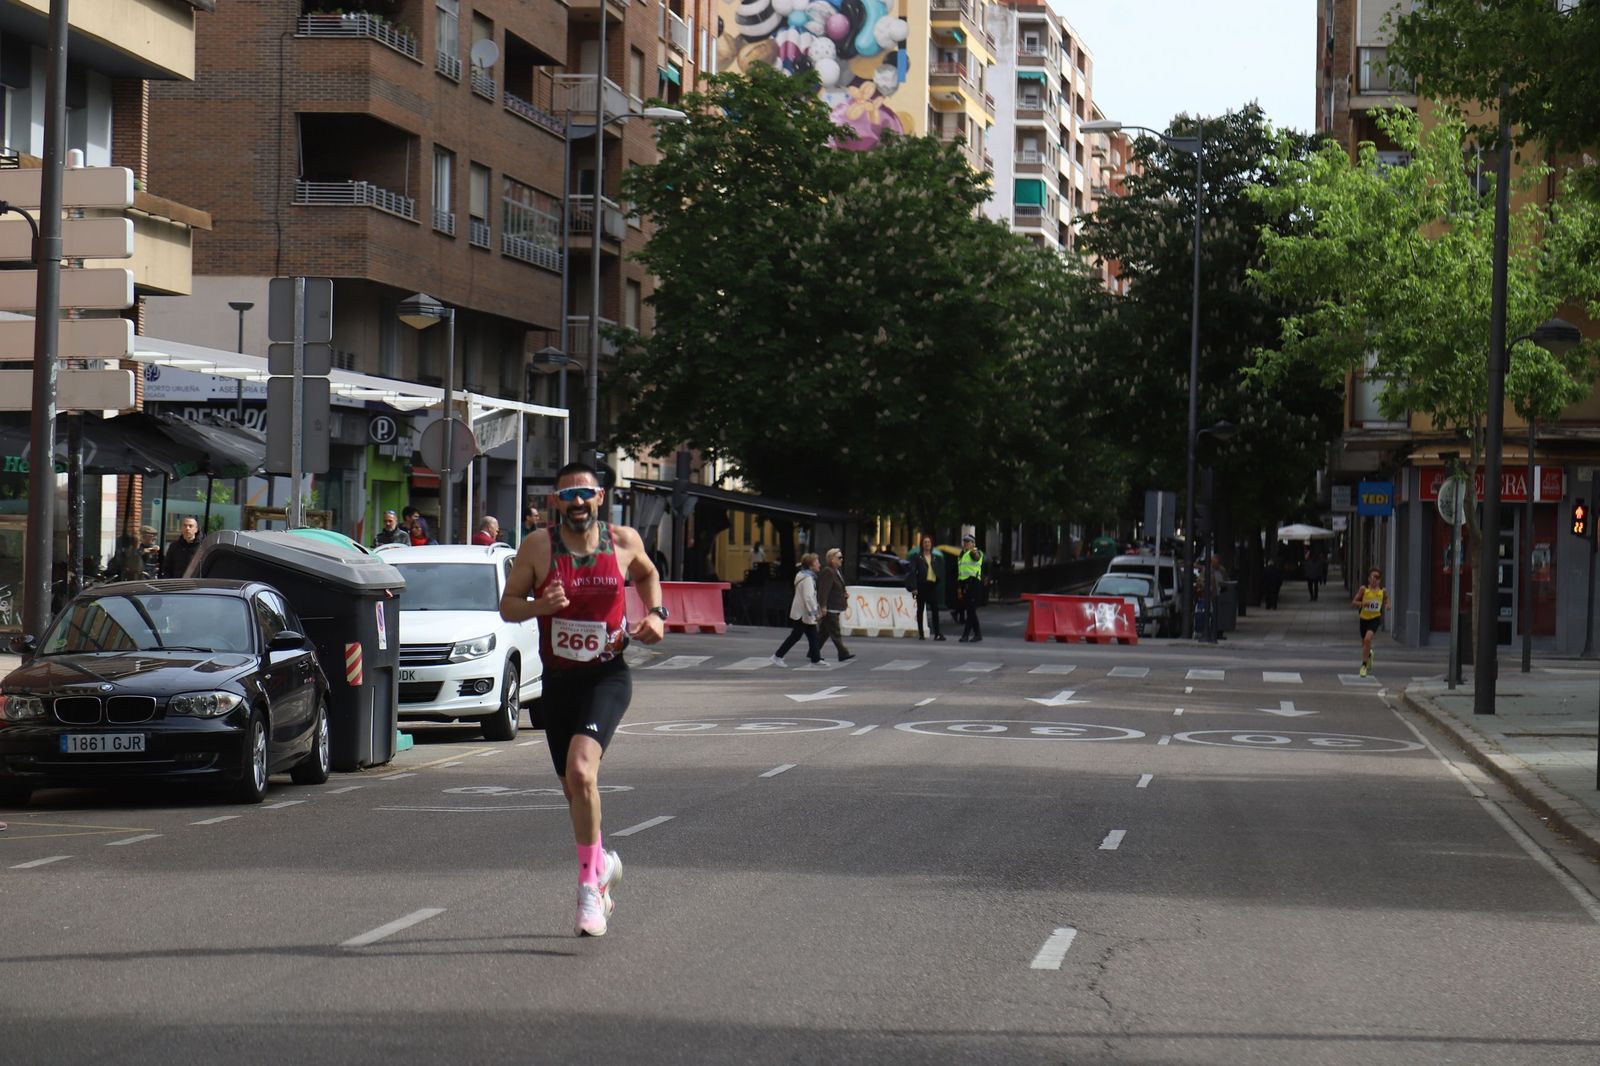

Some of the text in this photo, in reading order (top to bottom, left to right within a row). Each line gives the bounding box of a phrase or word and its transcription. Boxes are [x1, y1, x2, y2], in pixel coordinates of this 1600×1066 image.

[557, 631, 599, 651] 266
[72, 736, 141, 751] 1861 GJR
